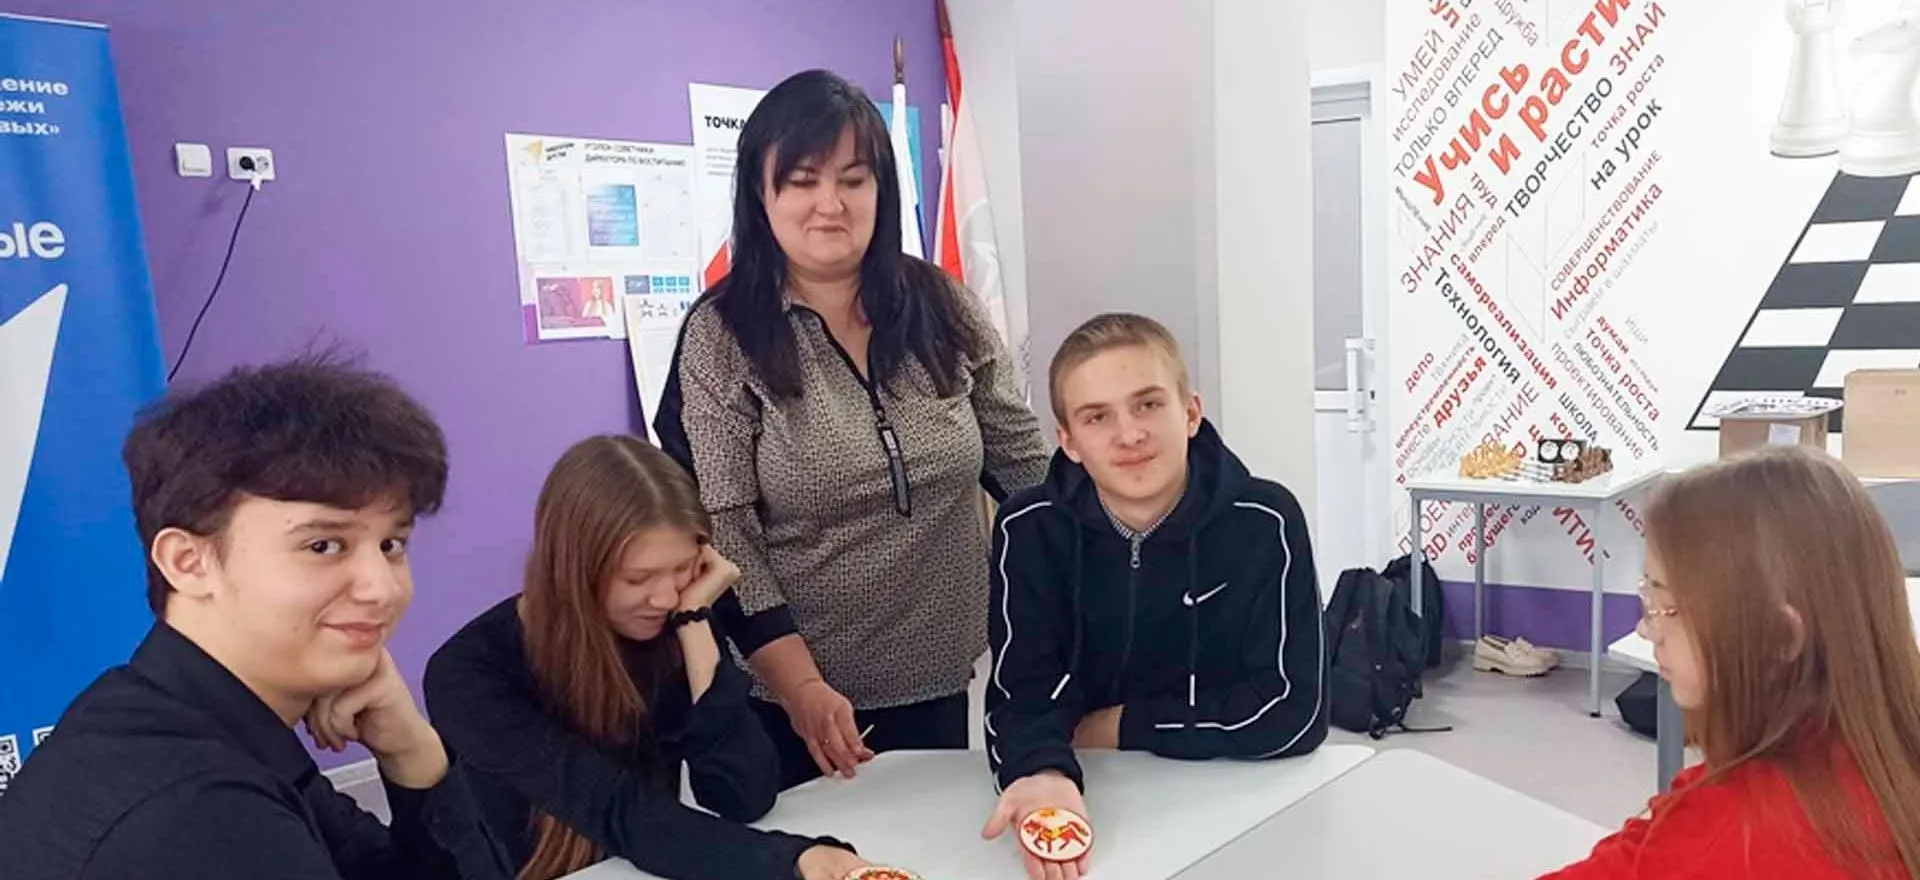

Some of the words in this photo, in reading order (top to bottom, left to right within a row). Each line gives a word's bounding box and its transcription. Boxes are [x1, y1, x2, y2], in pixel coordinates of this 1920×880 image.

[0, 78, 69, 96] ение
[1392, 29, 1445, 101] УМЕЙ
[1393, 13, 1482, 142] исследование
[1488, 133, 1521, 176] и
[1518, 0, 1630, 143] расти
[1609, 1, 1666, 76] ЗНАЙ
[1393, 106, 1447, 178] ТОЛЬКО
[1444, 28, 1504, 108] ВПЕРЕД
[1413, 64, 1530, 206] Учись
[1504, 77, 1612, 218] ТВОРЧЕСТВО
[1590, 159, 1617, 191] на
[1614, 98, 1663, 163] урок
[1591, 104, 1627, 149] точка
[1626, 54, 1665, 107] роста
[1469, 172, 1498, 210] труд
[1551, 150, 1662, 291] СОВЕРШЕНСТВОВАНИЕ
[1401, 192, 1476, 294] ЗНАНИЯ
[1550, 183, 1663, 320] Информатика
[1434, 266, 1521, 384] Технология
[1450, 252, 1558, 390] самореализация
[1405, 353, 1434, 392] дело
[1434, 356, 1486, 428] друзья
[1481, 381, 1540, 447] ВАНИЕ
[1551, 342, 1644, 460] проектирование
[1586, 327, 1622, 374] точка
[1618, 373, 1660, 422] роста
